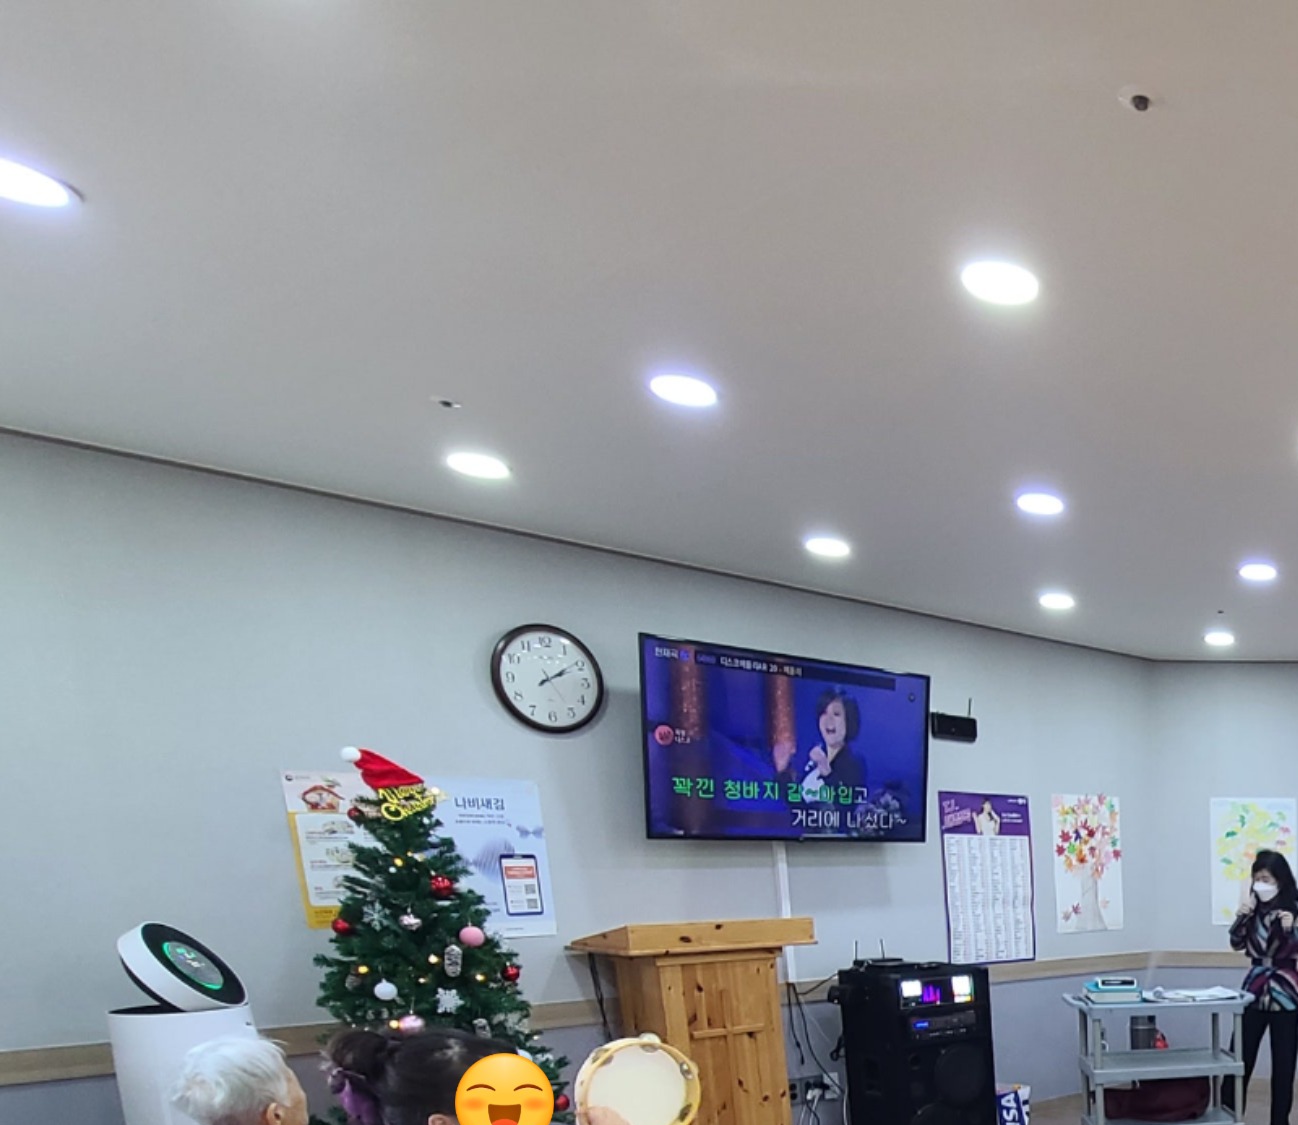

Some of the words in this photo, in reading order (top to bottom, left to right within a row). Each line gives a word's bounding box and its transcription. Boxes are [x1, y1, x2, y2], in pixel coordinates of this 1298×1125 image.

[521, 640, 531, 652] 11
[538, 636, 552, 648] 12
[508, 653, 520, 664] 10
[575, 660, 585, 671] 2
[505, 671, 515, 683] 9
[580, 678, 590, 689] 3
[513, 690, 523, 701] 8
[577, 695, 586, 705] 4
[528, 705, 537, 716] 7
[567, 707, 576, 718] 5
[548, 711, 557, 722] 6
[724, 779, 780, 801] 청바지
[791, 808, 840, 829] 거리에
